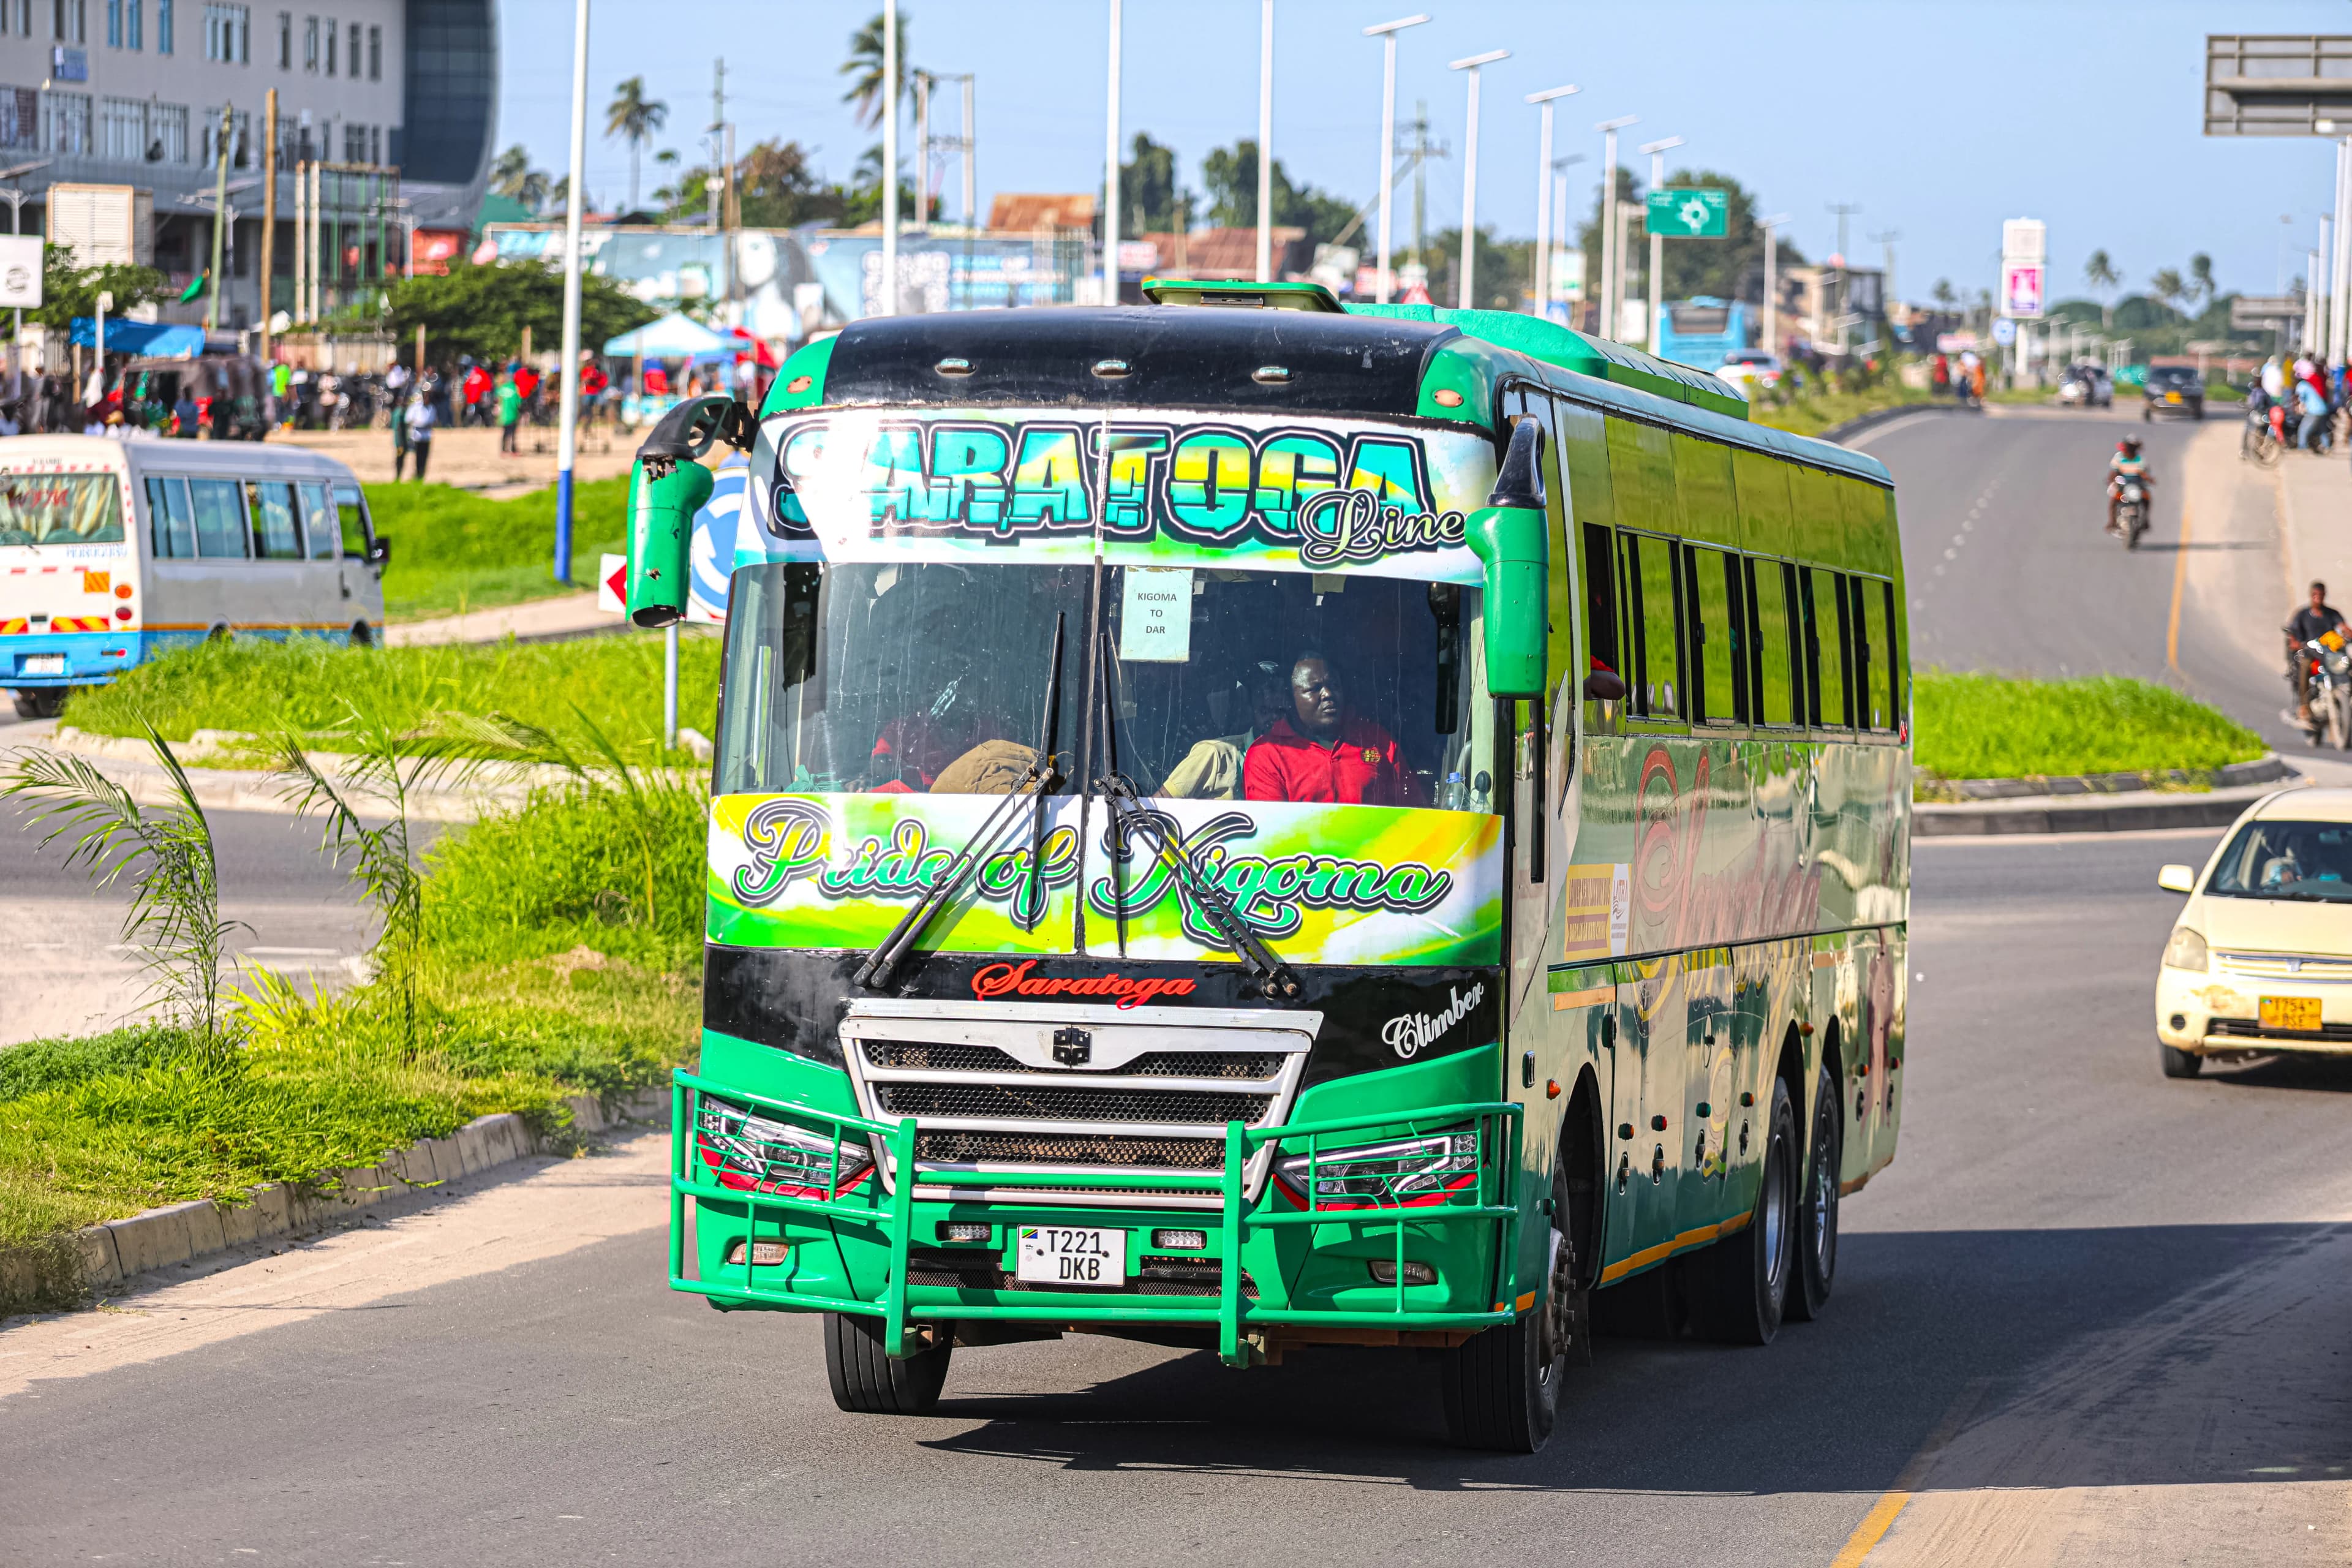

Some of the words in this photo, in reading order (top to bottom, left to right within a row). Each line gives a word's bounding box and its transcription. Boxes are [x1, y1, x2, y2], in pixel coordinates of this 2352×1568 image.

[1298, 489, 1466, 566] Line
[1137, 592, 1177, 601] KIGOMA
[1150, 609, 1163, 617] TO
[1146, 625, 1166, 634] DAR
[732, 797, 973, 907] Pride
[976, 824, 1080, 930] of
[1087, 809, 1453, 951] Kigoma
[1613, 879, 1628, 902] LATRA
[971, 959, 1197, 1010] Saratoga
[1381, 982, 1484, 1058] Climber
[1047, 1229, 1102, 1254] T221
[1059, 1256, 1101, 1280] DKB
